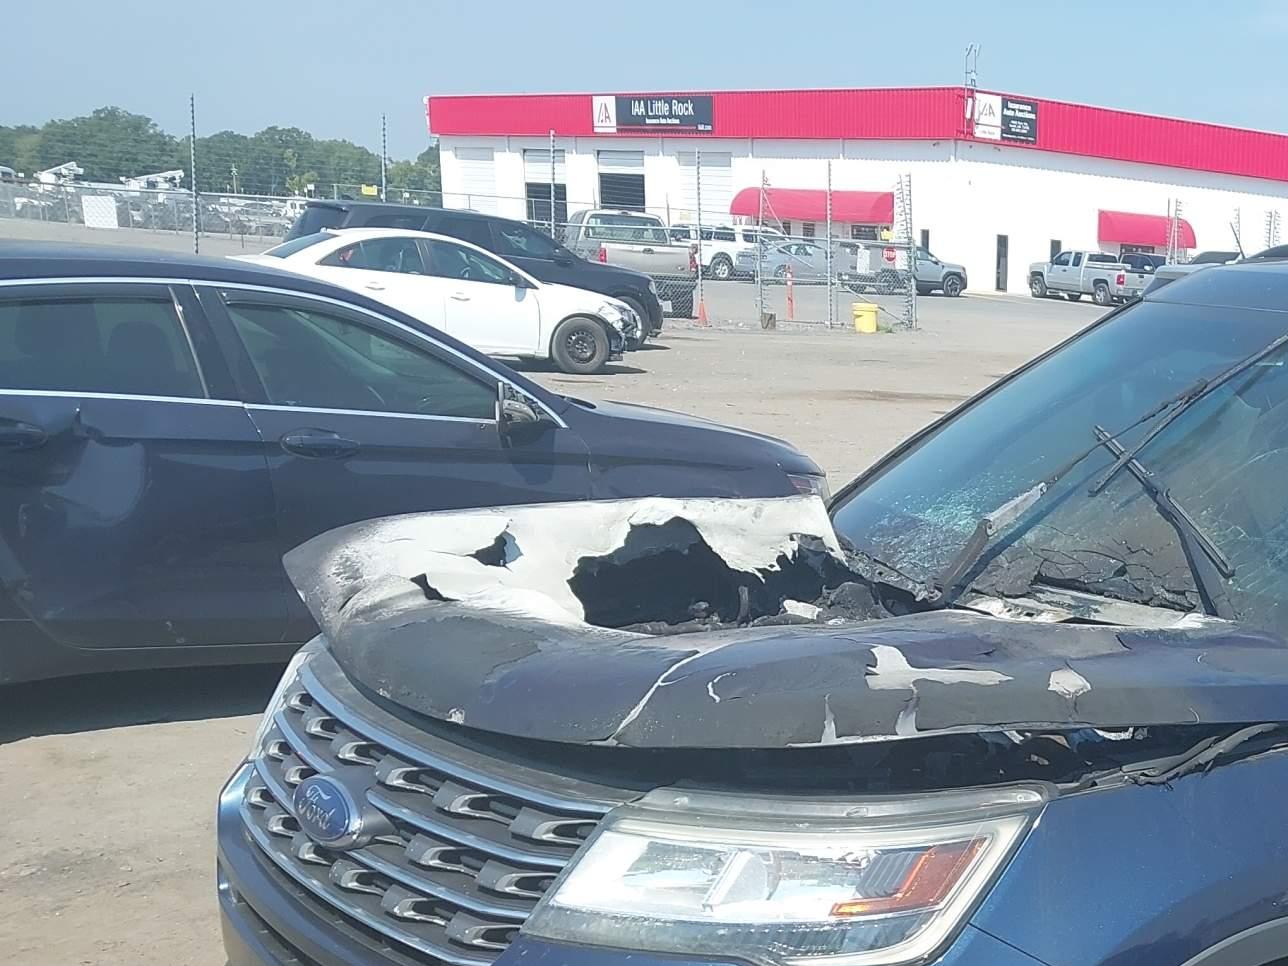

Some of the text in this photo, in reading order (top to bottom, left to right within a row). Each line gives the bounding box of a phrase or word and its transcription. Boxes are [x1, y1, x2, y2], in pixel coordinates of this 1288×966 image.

[631, 100, 694, 115] IAA Little Rock
[298, 784, 336, 831] Ford
